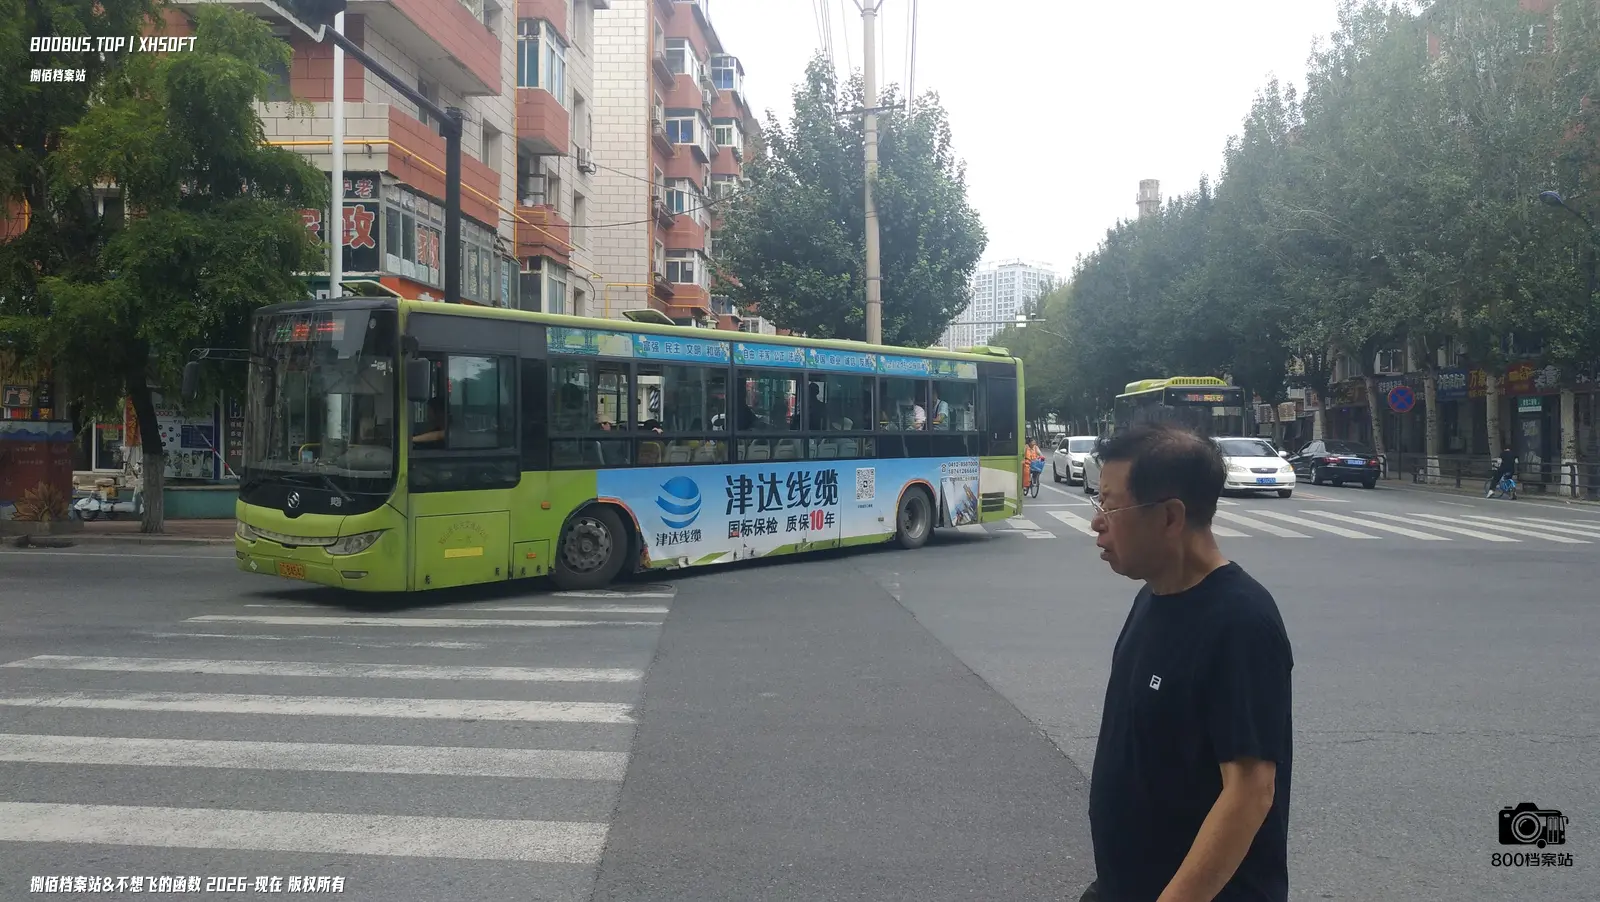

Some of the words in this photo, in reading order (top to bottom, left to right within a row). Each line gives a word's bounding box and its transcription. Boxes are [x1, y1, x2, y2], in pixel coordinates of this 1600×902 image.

[665, 342, 681, 355] 民主
[725, 468, 839, 515] 津达线缆
[727, 517, 778, 539] 国标保检
[785, 509, 836, 532] 质保10年
[655, 528, 702, 547] 津达线缆
